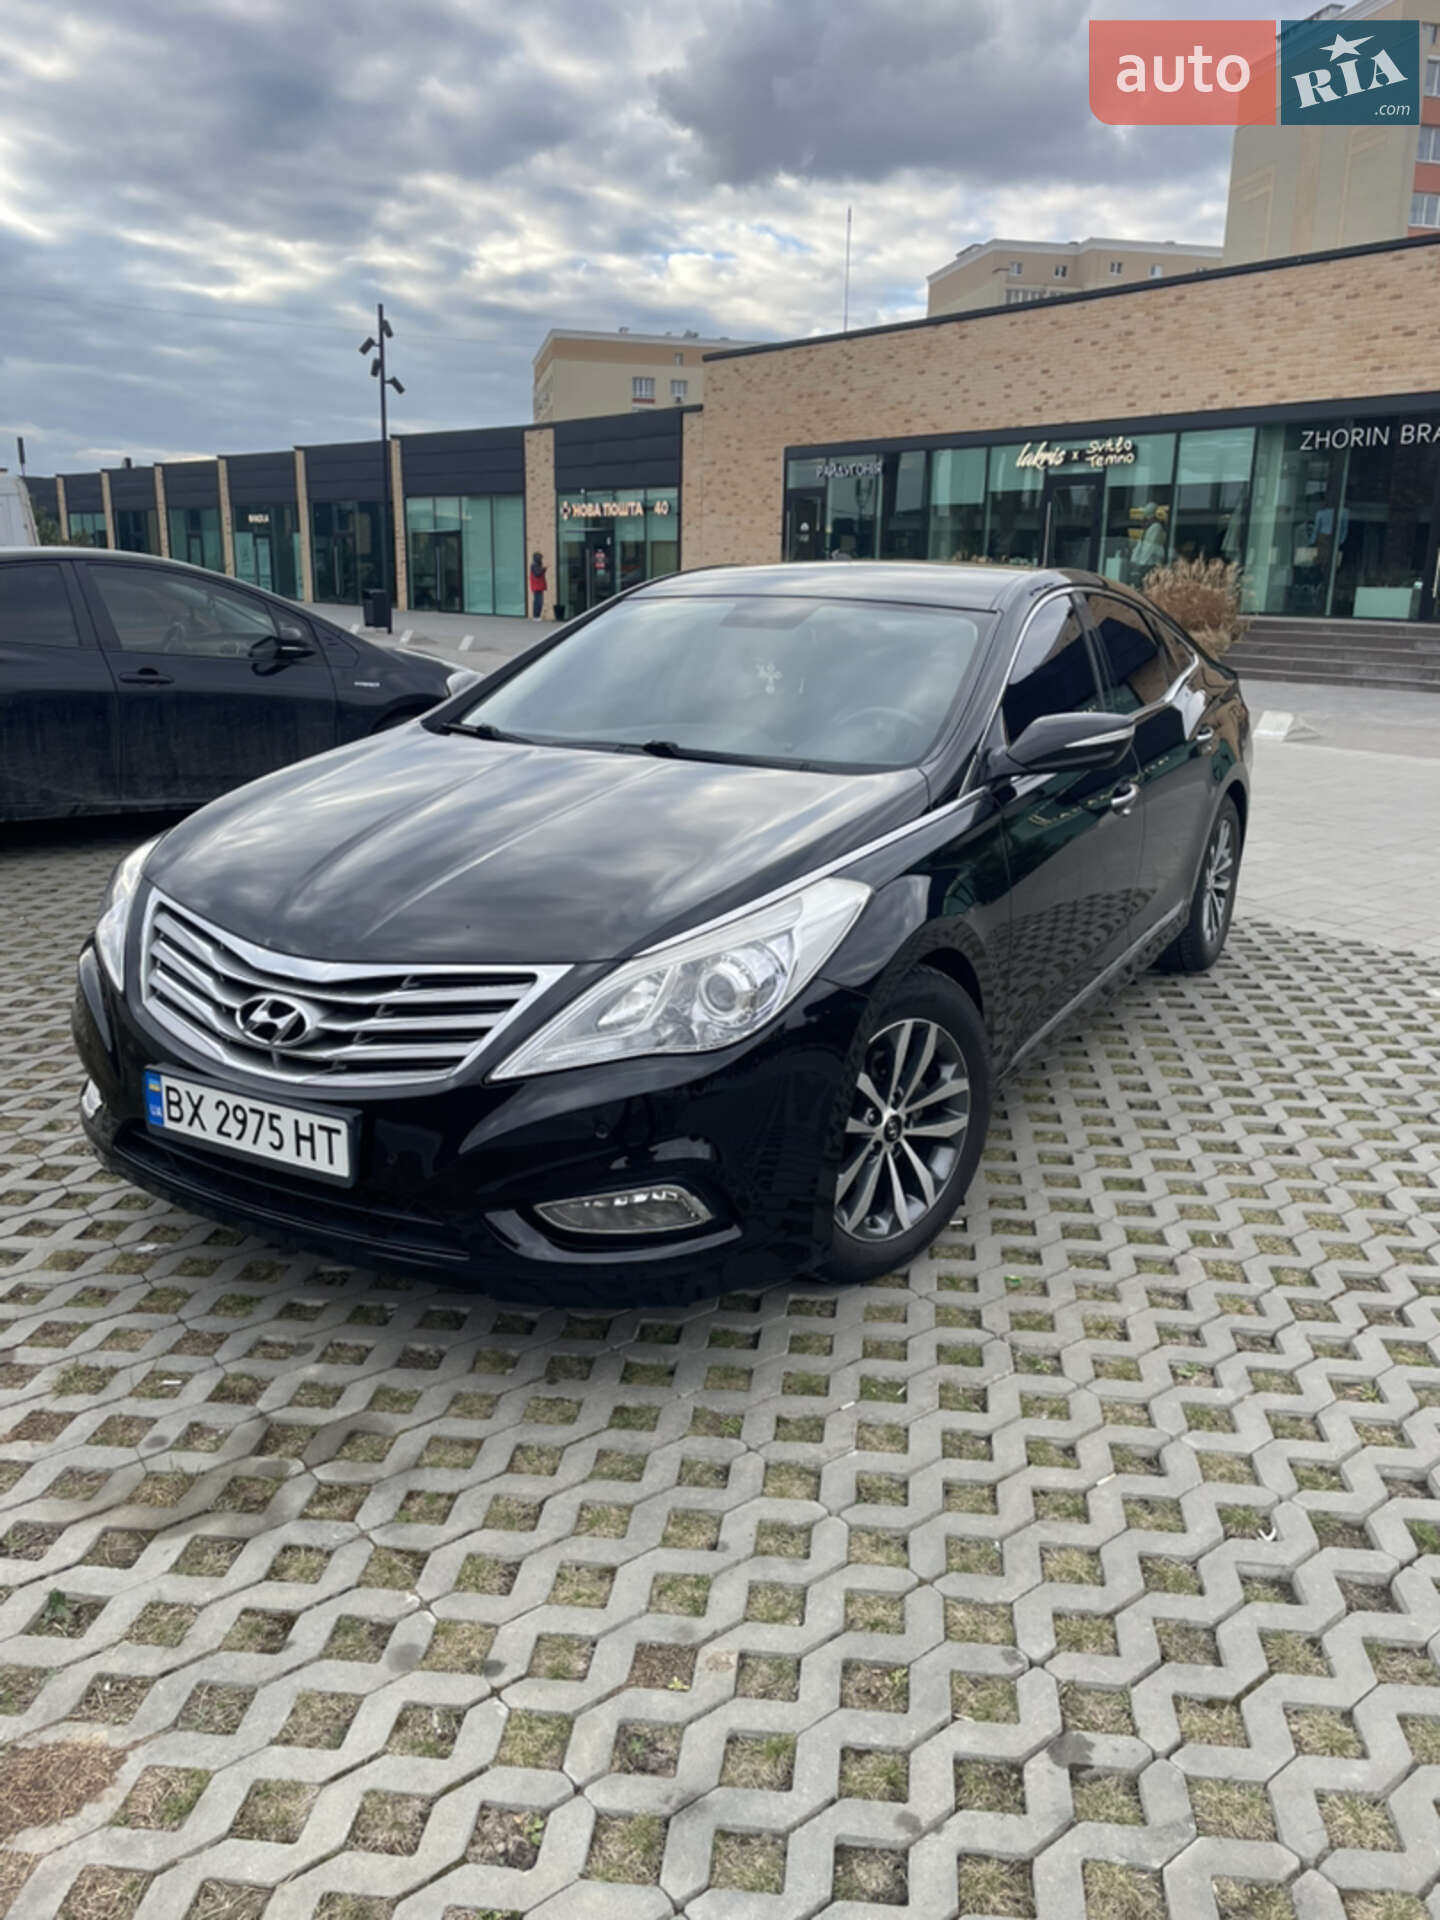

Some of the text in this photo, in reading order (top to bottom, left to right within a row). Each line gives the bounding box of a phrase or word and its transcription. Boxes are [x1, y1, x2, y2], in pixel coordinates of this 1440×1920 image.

[1300, 425, 1390, 450] ZHORIN
[571, 500, 670, 517] НОВА ПОШТА 40
[165, 1085, 342, 1165] BX 2975 HT
